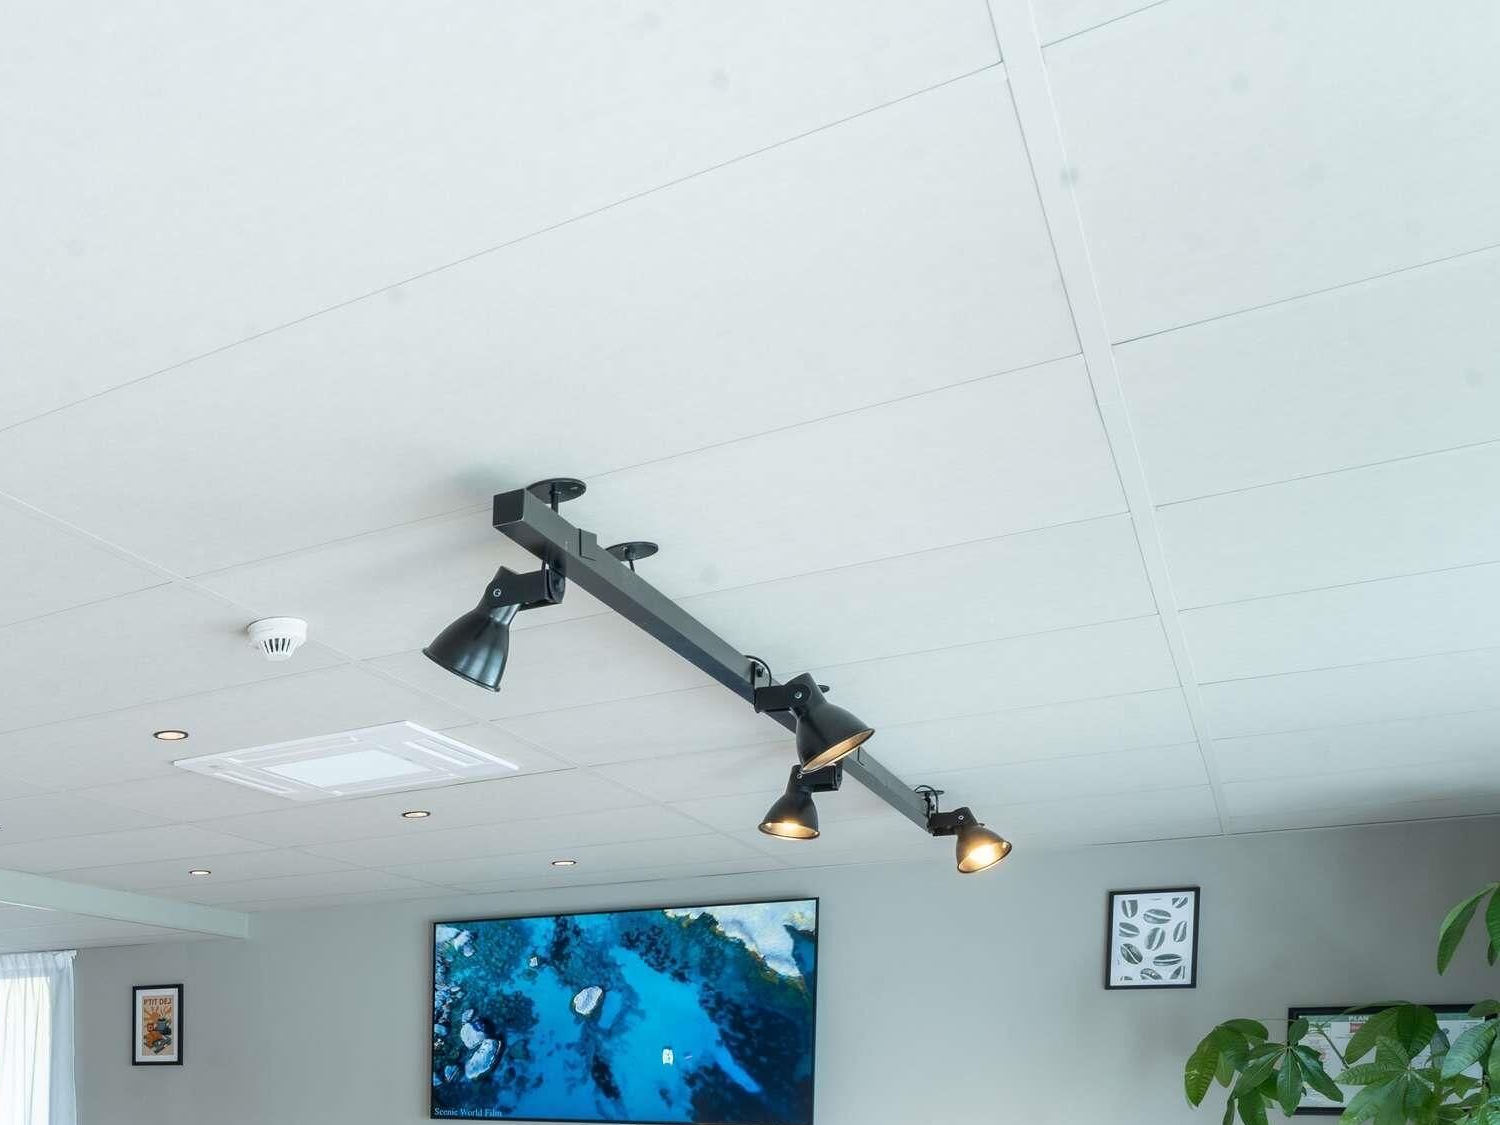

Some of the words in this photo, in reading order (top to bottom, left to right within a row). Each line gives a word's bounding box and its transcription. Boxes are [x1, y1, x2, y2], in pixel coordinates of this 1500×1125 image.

[434, 1107, 458, 1116] Scenic
[460, 1107, 482, 1117] World
[485, 1107, 502, 1117] Film
